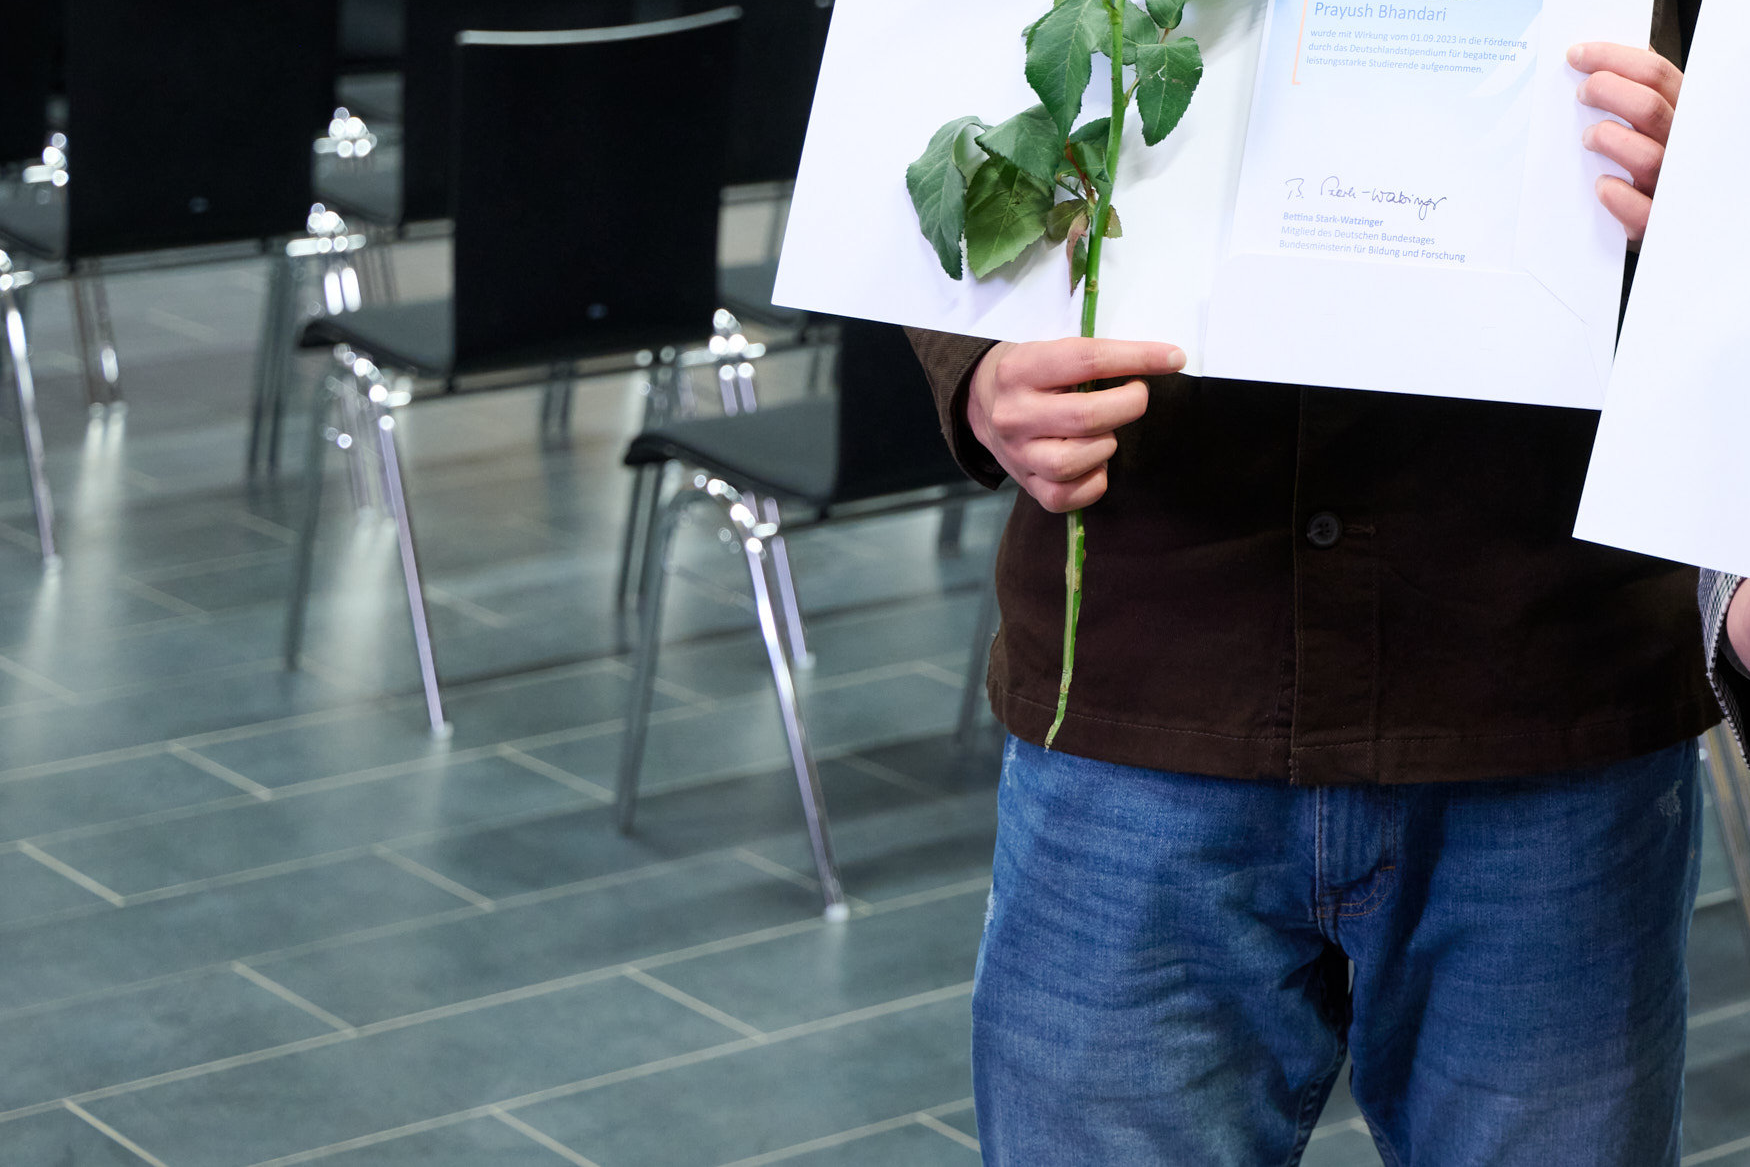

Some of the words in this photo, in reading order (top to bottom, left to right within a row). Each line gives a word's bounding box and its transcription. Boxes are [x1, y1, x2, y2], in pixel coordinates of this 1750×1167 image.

[1315, 2, 1373, 20] Prayush
[1378, 4, 1447, 22] Bhandari
[1310, 29, 1336, 38] wurde
[1338, 30, 1352, 39] mit
[1354, 31, 1388, 41] Wirkung
[1410, 34, 1457, 44] 01.09.2023
[1459, 36, 1467, 44] in
[1469, 36, 1481, 45] die
[1484, 37, 1527, 49] Förderung
[1308, 42, 1332, 51] durch
[1334, 44, 1348, 52] das
[1349, 44, 1446, 58] Deutschlandstipendium
[1448, 49, 1460, 58] für
[1463, 50, 1497, 61] begabte
[1499, 52, 1516, 62] und
[1306, 56, 1366, 68] leistungsstarke
[1368, 58, 1418, 70] Studierende
[1420, 62, 1484, 74] aufgenommen.
[1283, 212, 1313, 222] Bettina
[1316, 214, 1384, 227] Stark-Watzinger
[1281, 226, 1316, 237] Mitglied
[1317, 229, 1332, 238] des
[1334, 230, 1378, 241] Deutschen
[1381, 233, 1435, 245] Bundestages
[1279, 240, 1351, 252] Bundesministerin
[1354, 245, 1366, 254] für
[1368, 246, 1400, 258] Bildung
[1402, 249, 1419, 258] und
[1421, 250, 1466, 263] Forschung
